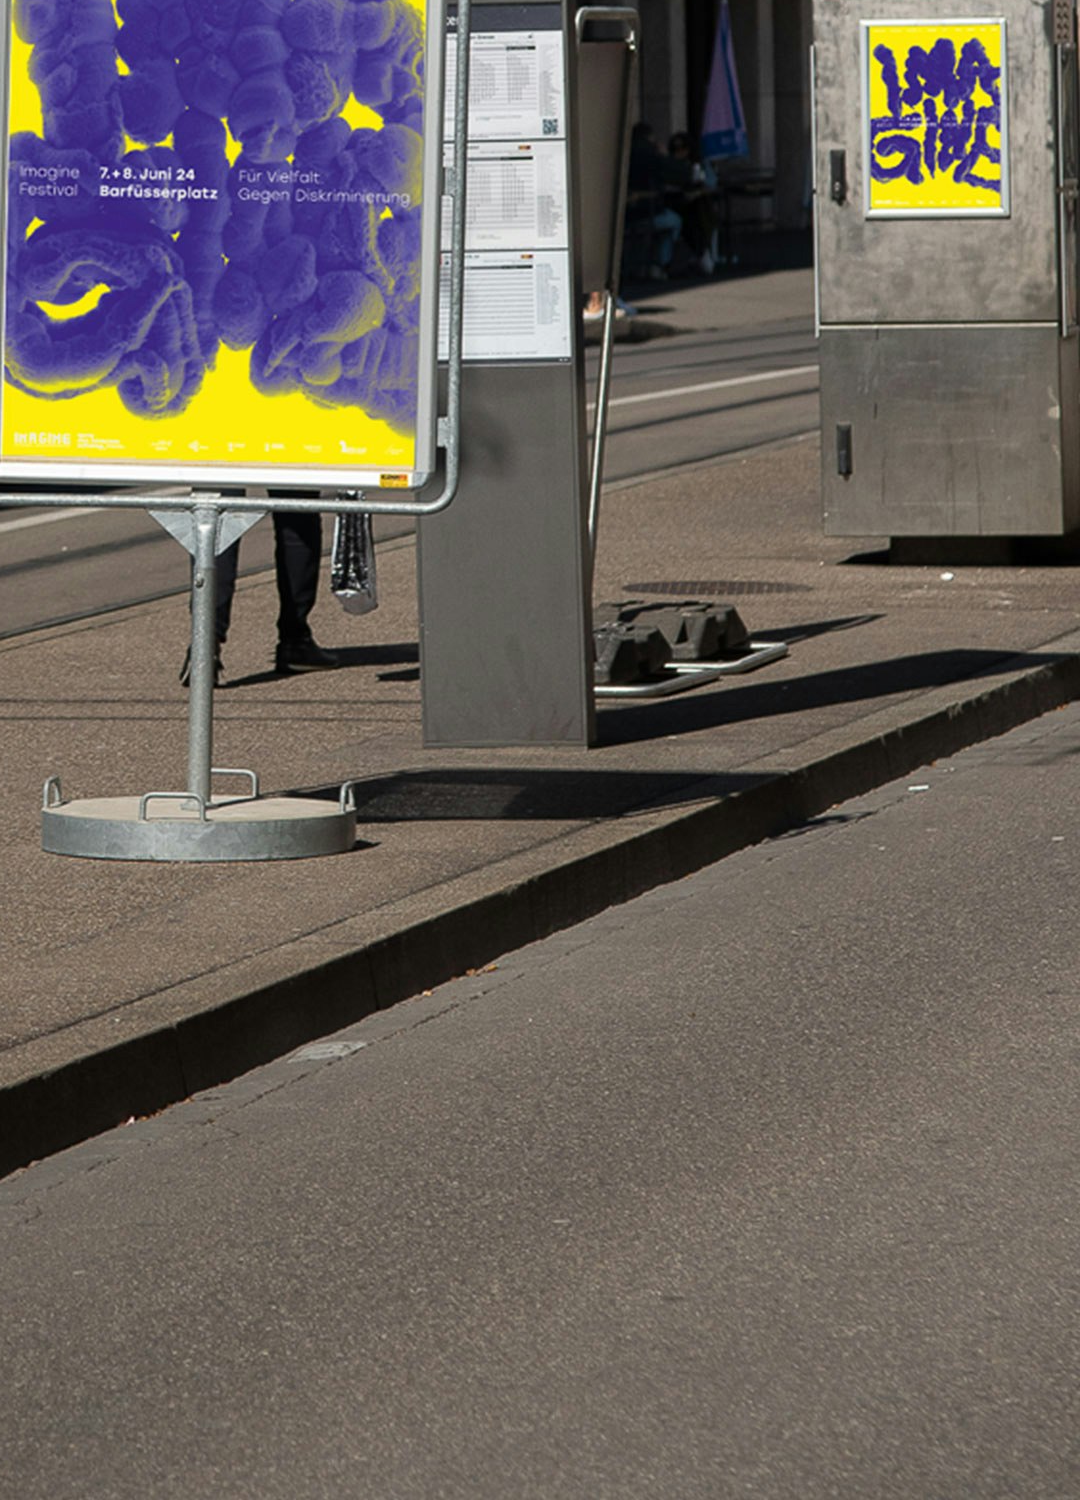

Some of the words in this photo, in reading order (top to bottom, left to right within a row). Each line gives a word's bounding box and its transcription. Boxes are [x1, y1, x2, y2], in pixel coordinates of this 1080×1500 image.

[19, 164, 80, 181] Imagine
[140, 166, 172, 181] Juni
[176, 168, 196, 181] 24
[238, 169, 261, 183] Für
[19, 182, 78, 197] Festival
[99, 184, 218, 201] Barfüsserplatz
[237, 187, 290, 204] Gegen
[295, 187, 411, 208] Diskriminierung
